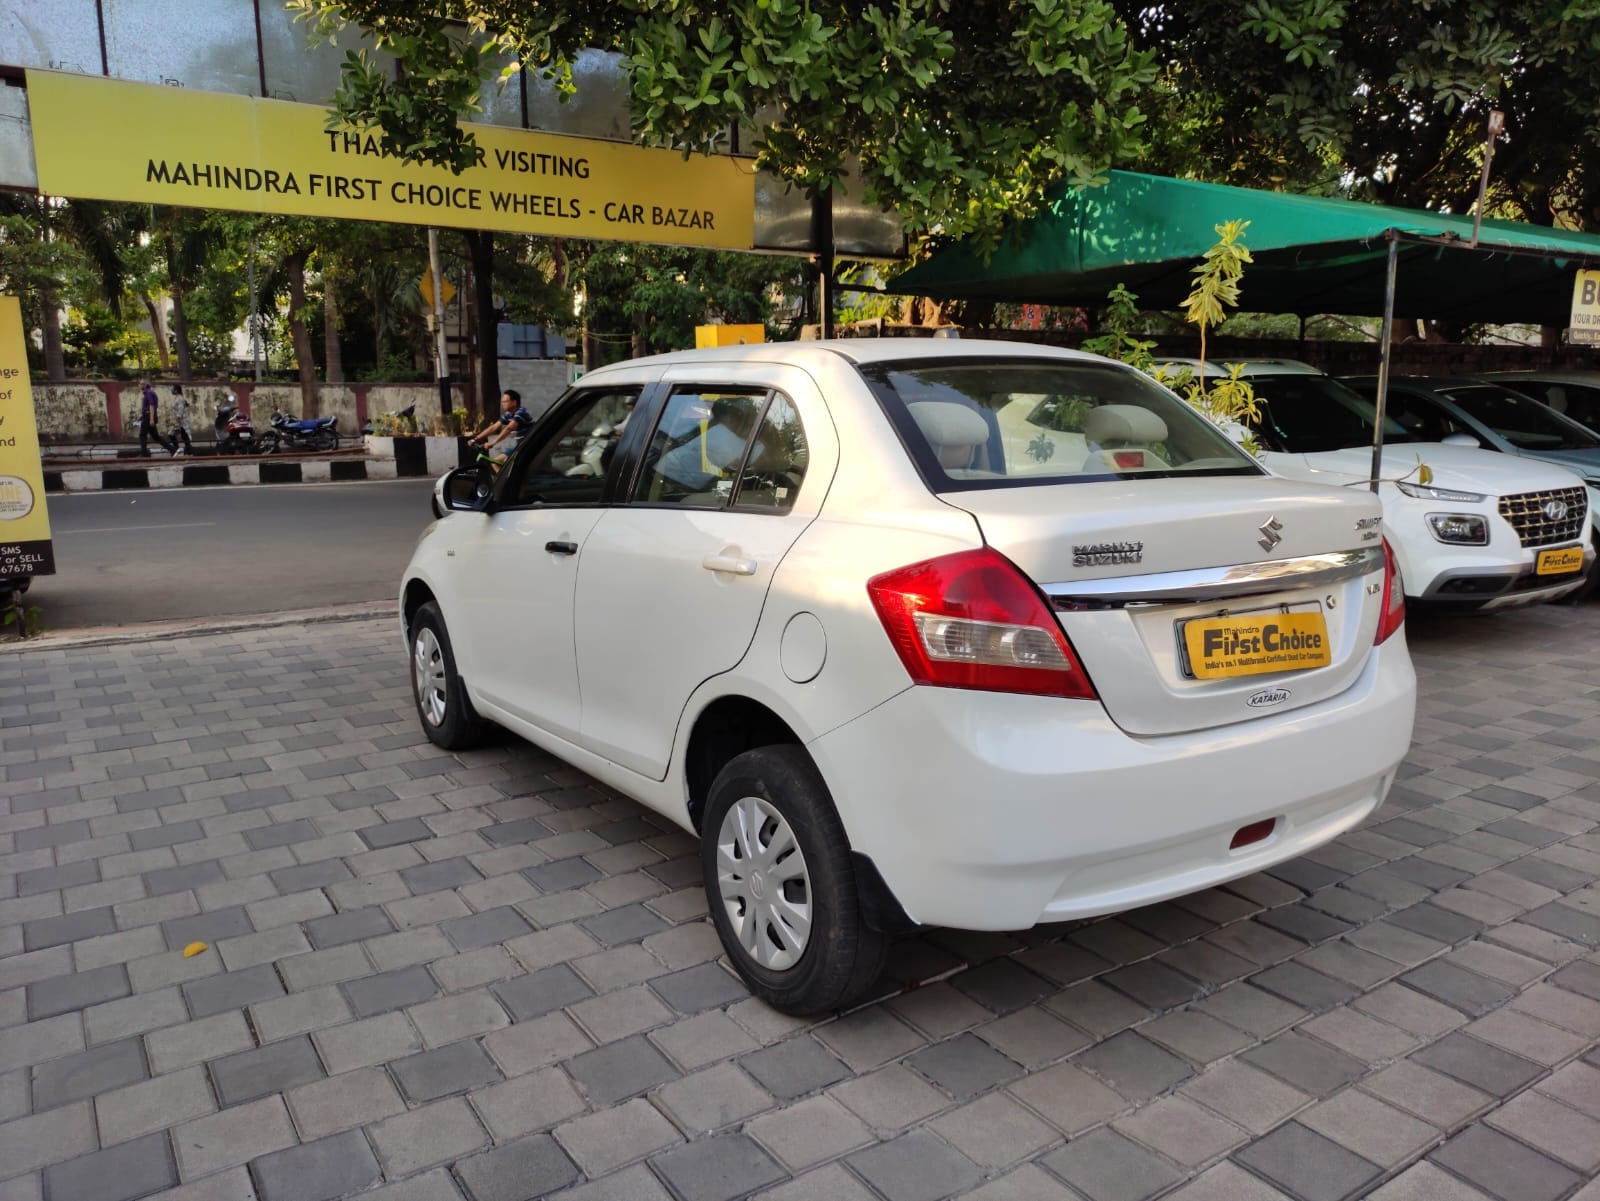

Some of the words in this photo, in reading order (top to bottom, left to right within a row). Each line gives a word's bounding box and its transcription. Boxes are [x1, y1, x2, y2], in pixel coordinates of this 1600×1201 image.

[495, 148, 590, 178] VISITING
[146, 159, 300, 194] MAHINDRA
[309, 174, 382, 201] FIRST
[391, 182, 481, 209] CHOICE
[490, 191, 581, 218] WHEELS
[604, 202, 645, 224] CAR
[652, 207, 715, 230] BAZAR
[1581, 279, 1600, 305] B
[1, 546, 21, 555] SMS
[19, 553, 44, 563] SELL
[1072, 551, 1142, 567] SUZUKI
[1204, 629, 1261, 657] First
[1262, 625, 1321, 652] Choice
[1251, 692, 1287, 704] KATARIA
